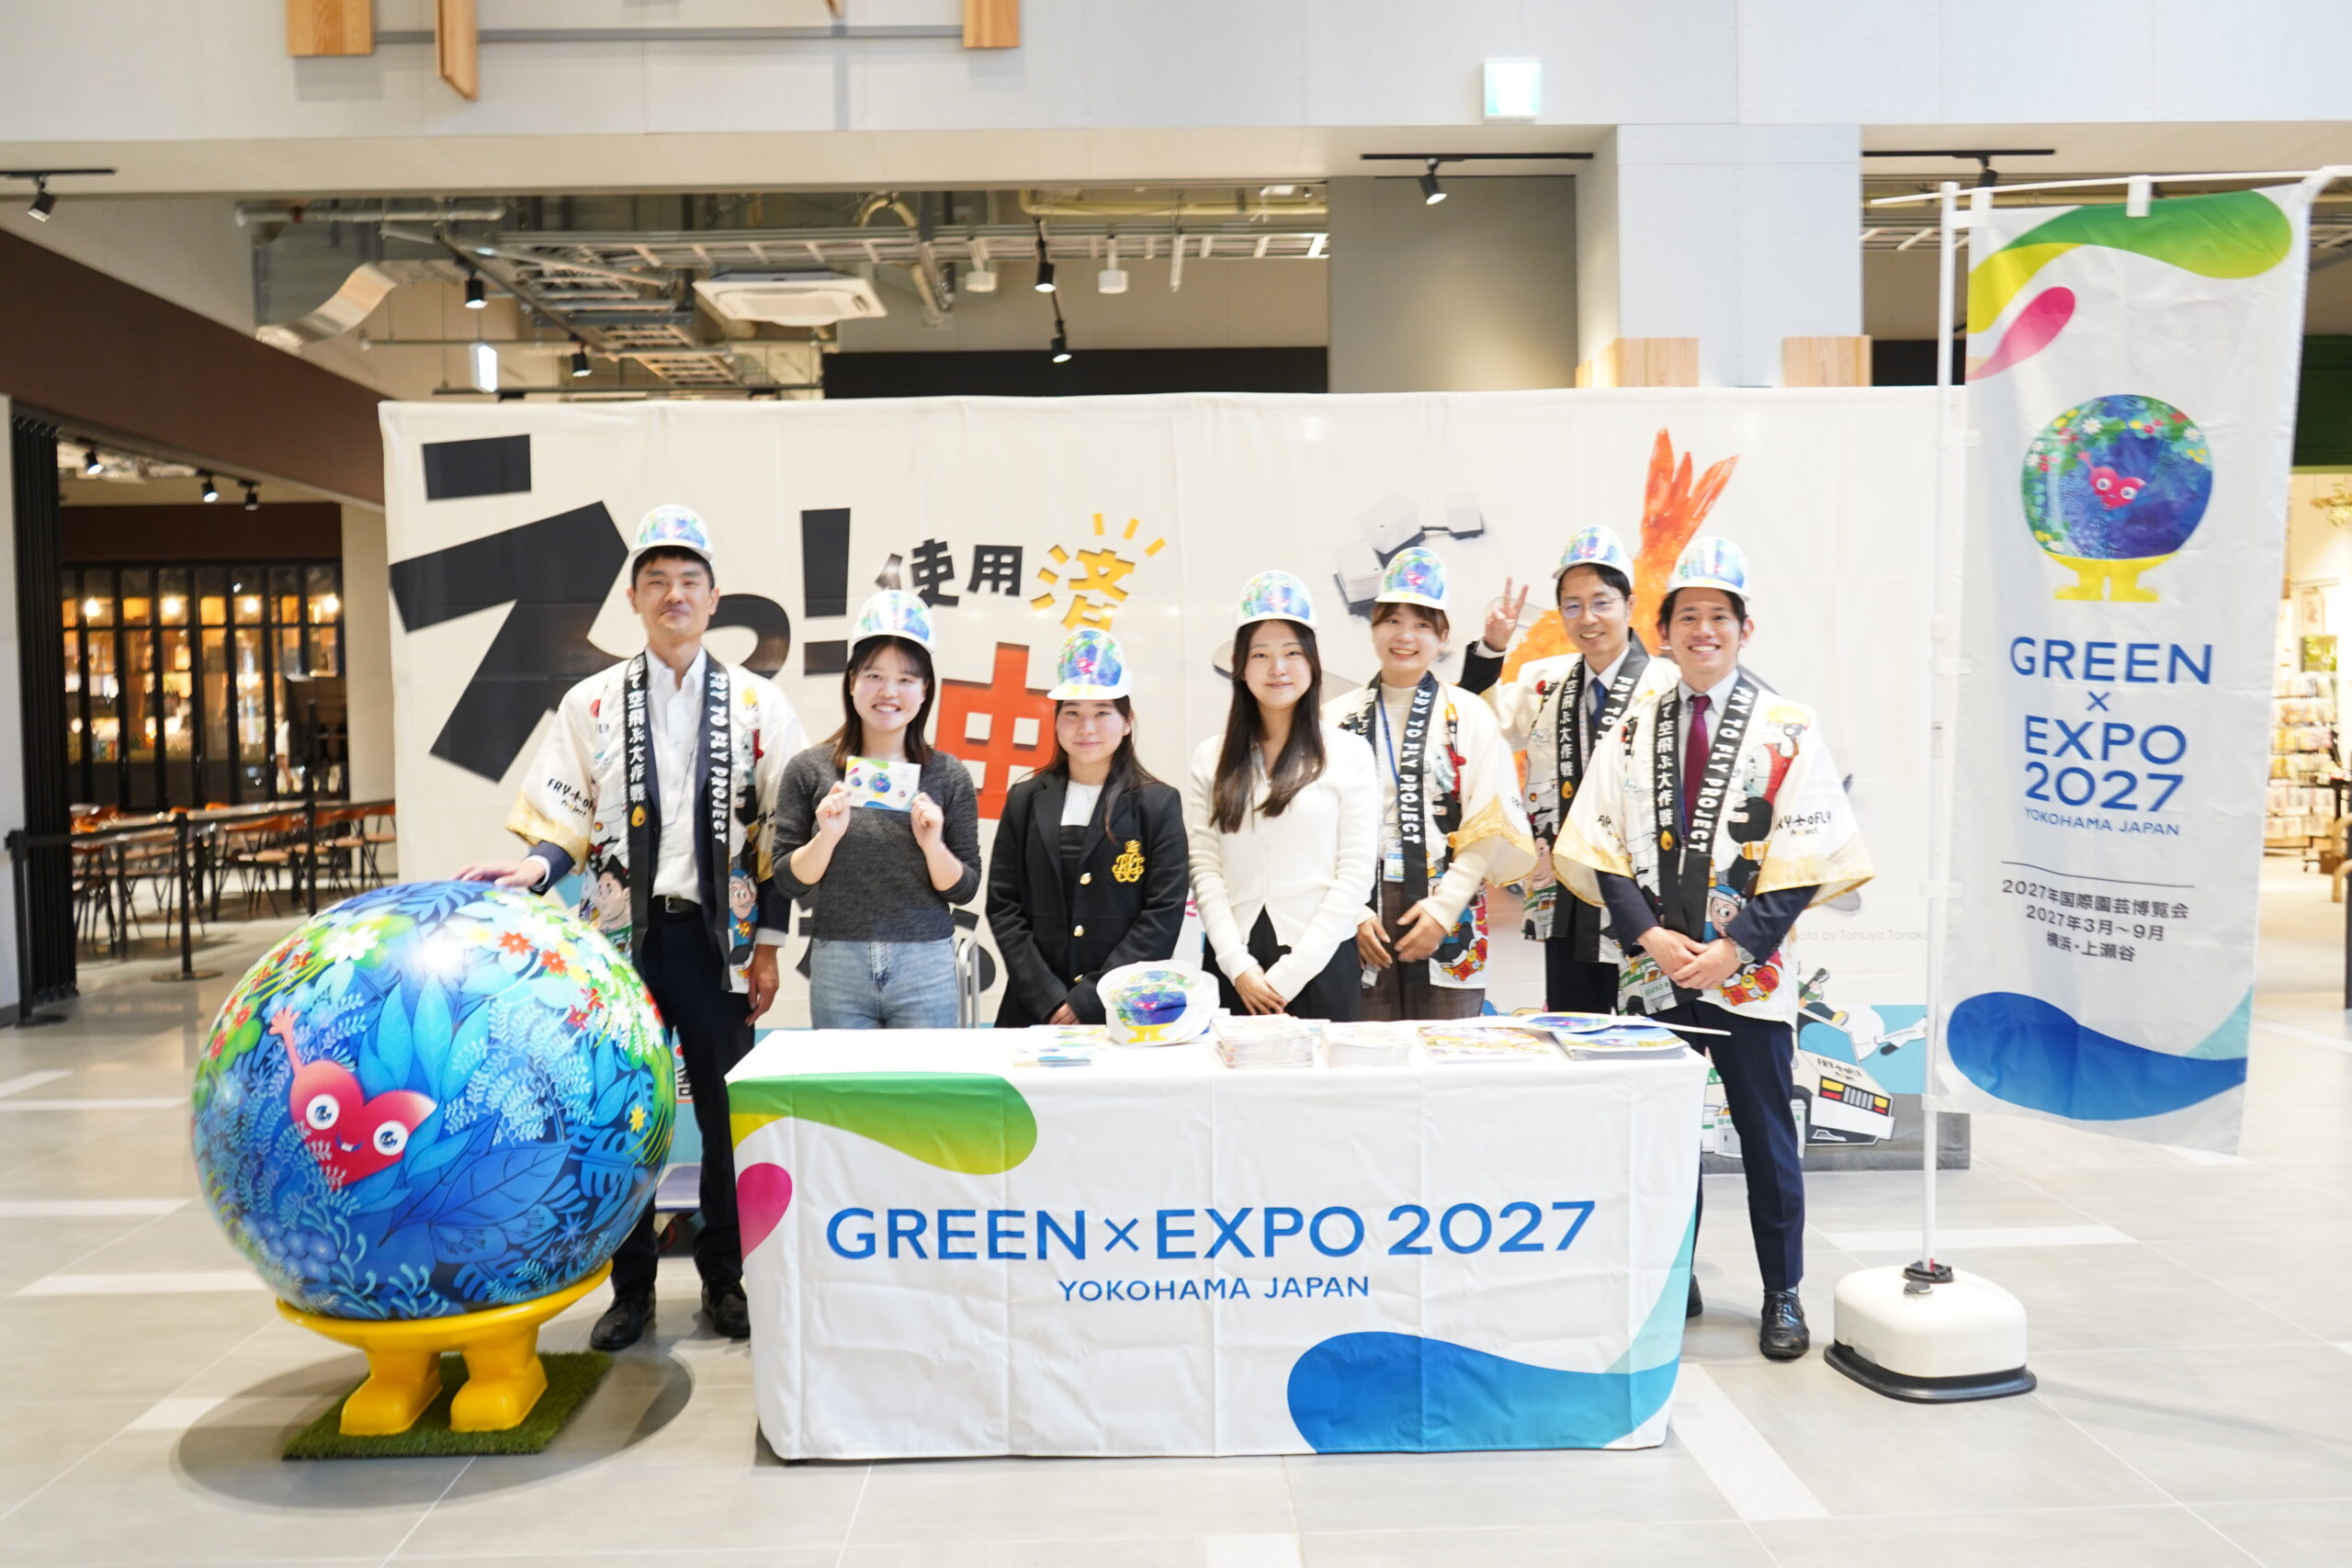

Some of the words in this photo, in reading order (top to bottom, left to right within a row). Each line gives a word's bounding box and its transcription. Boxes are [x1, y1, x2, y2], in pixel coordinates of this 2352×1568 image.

[2009, 636, 2212, 685] GREEN
[710, 671, 728, 702] FRY
[1412, 688, 1432, 715] FRY
[1610, 676, 1634, 703] FRY
[1727, 684, 1754, 717] FRY
[710, 706, 728, 727] TO
[1406, 719, 1424, 738] TO
[1601, 706, 1623, 726] TO
[1719, 721, 1745, 739] TO
[710, 730, 729, 762] FLY
[1400, 742, 1422, 769] FLY
[2024, 715, 2188, 765] EXPO
[1708, 742, 1736, 773] FLY
[2024, 761, 2185, 812] 2027
[711, 765, 729, 843] PROJECT
[1399, 773, 1421, 844] PROJECT
[1688, 777, 1726, 853] PROJECT
[2024, 807, 2113, 831] YOKOHAMA
[2119, 820, 2180, 837] JAPAN
[2002, 879, 2190, 919] 2027年国際園芸博覧会
[1822, 929, 1838, 944] by
[1839, 929, 1885, 944] Tatsuya
[826, 1207, 1086, 1260] GREEN
[1157, 1206, 1365, 1259] EXPO
[1387, 1201, 1596, 1256] 2027
[1057, 1278, 1251, 1303] YOKOHAMA
[1263, 1276, 1370, 1300] JAPAN
